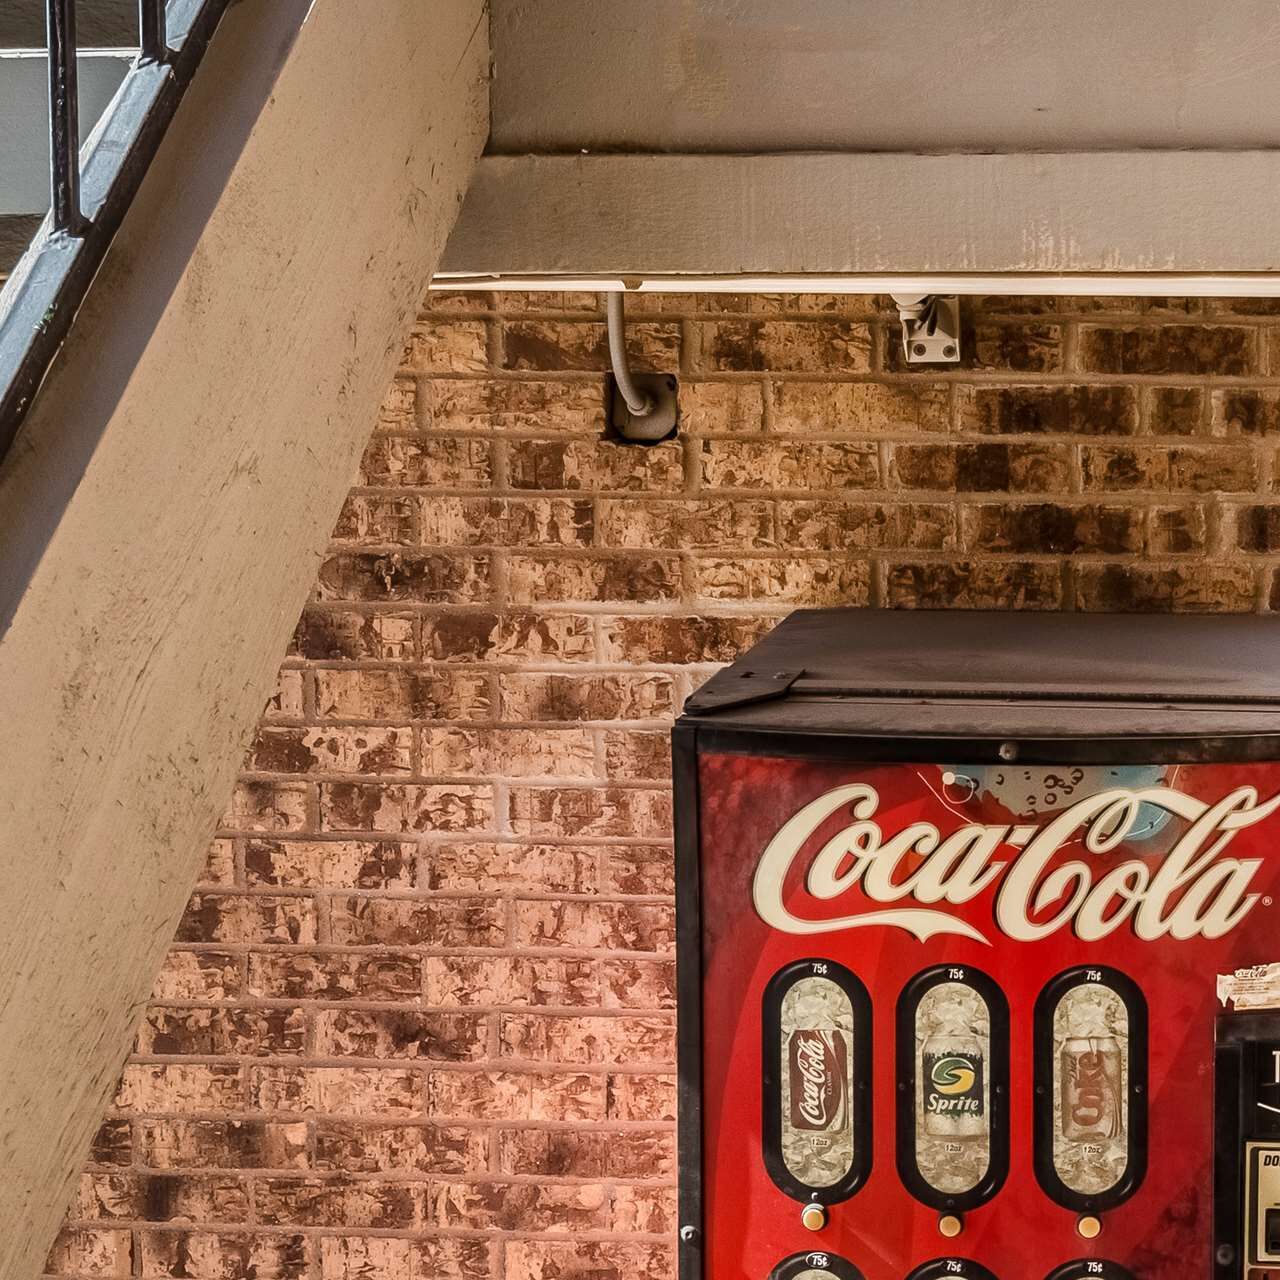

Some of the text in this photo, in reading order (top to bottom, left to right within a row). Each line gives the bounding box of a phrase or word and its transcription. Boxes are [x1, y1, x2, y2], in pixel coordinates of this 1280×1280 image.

[812, 963, 828, 975] 75¢
[948, 968, 964, 980] 75¢
[1085, 970, 1102, 982] 75¢
[1072, 1051, 1105, 1126] Coke
[927, 1092, 979, 1112] Sprite
[812, 1254, 828, 1266] 75¢
[946, 1261, 962, 1272] 75¢
[1087, 1262, 1103, 1273] 75¢
